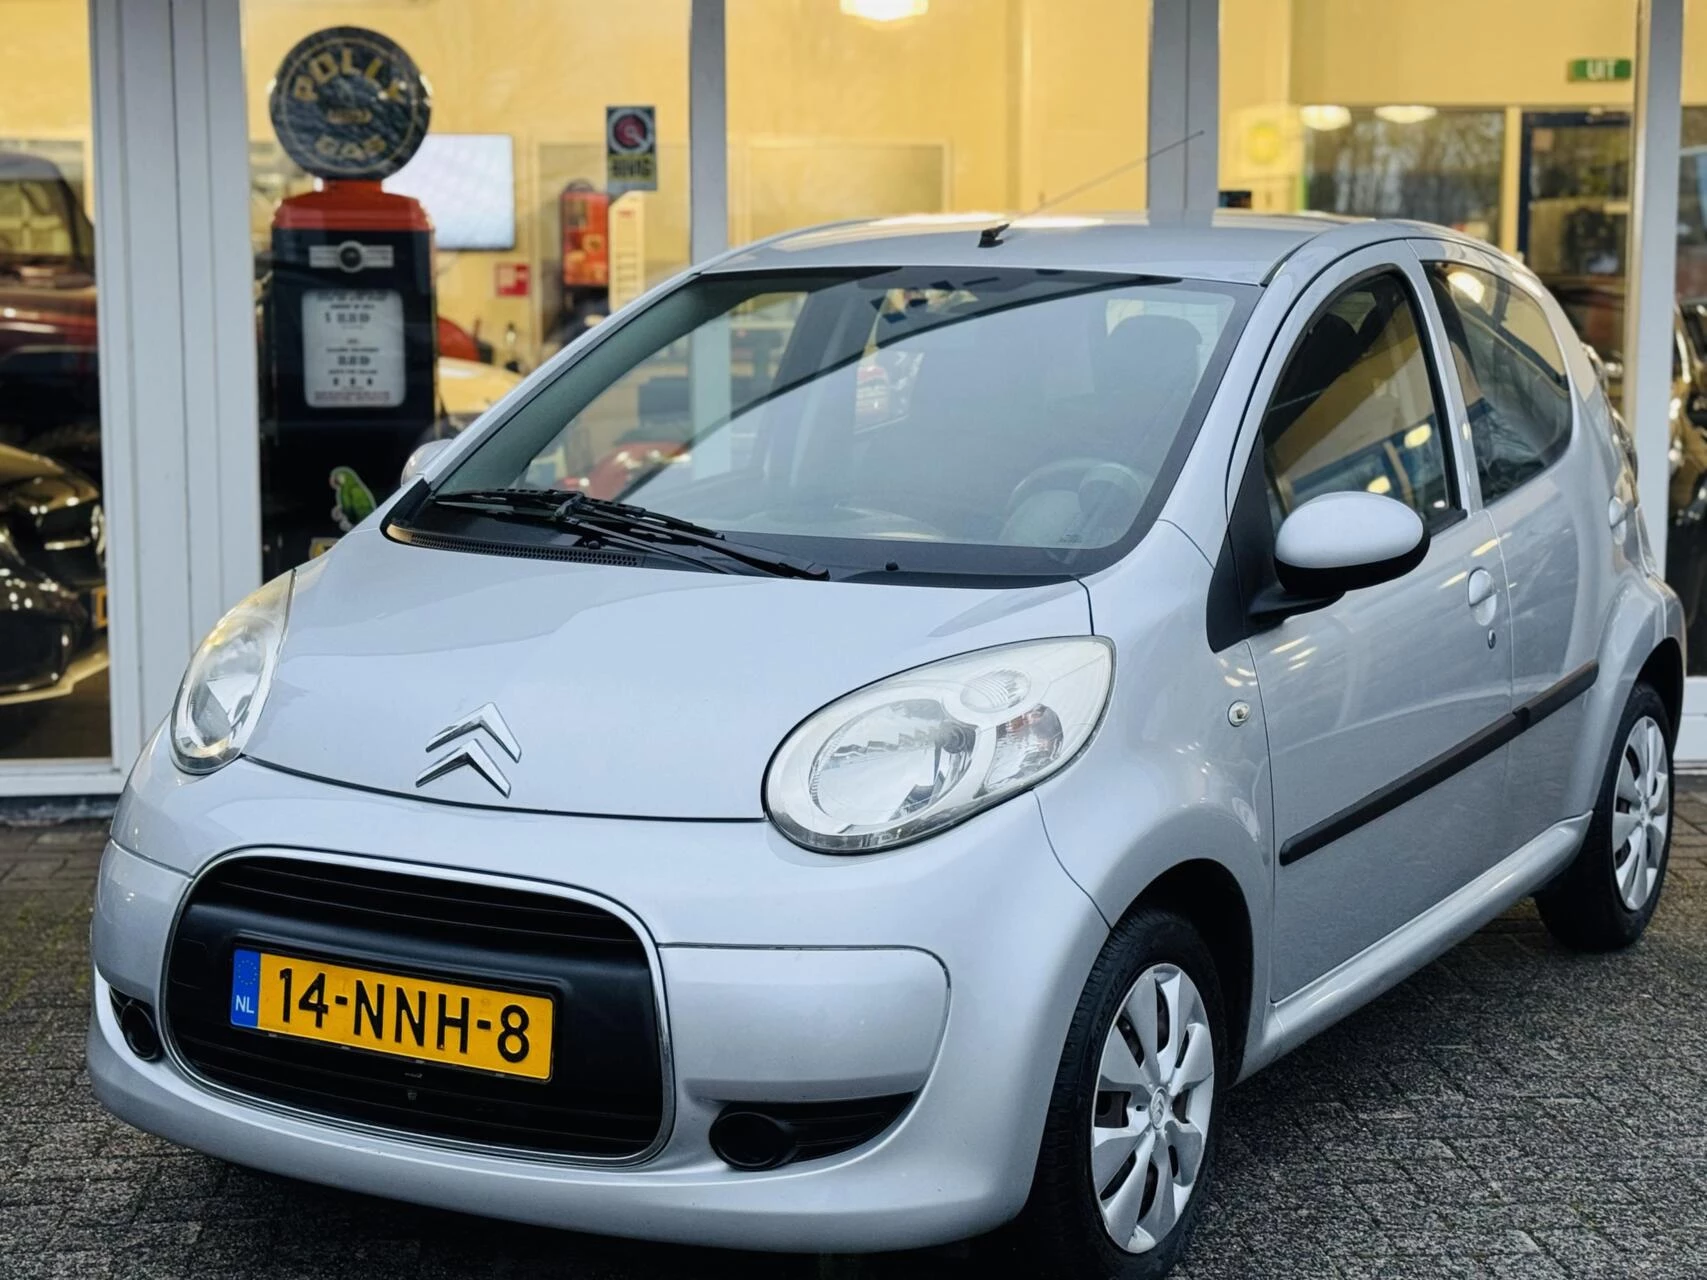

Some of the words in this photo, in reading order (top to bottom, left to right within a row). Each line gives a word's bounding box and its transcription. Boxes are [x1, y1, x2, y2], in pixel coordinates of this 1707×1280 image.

[1585, 59, 1616, 81] UIT
[234, 994, 255, 1014] NL
[279, 967, 530, 1063] 14-NNH-8
